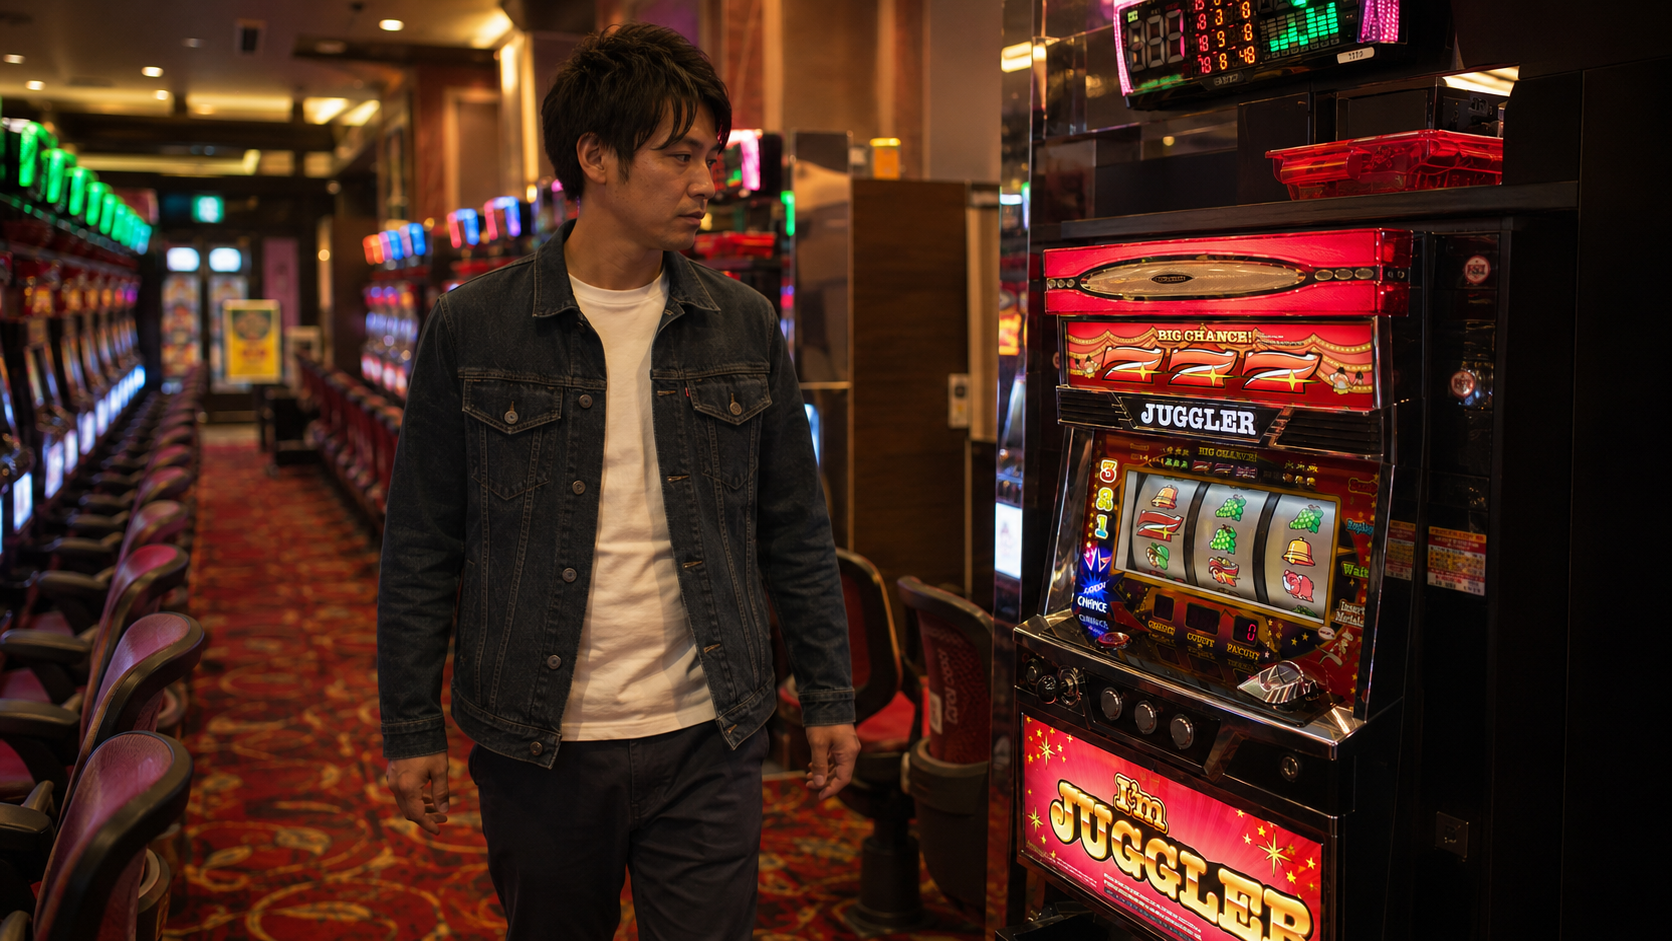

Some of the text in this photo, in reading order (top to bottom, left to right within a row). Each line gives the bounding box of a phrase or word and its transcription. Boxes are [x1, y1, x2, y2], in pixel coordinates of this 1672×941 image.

[1157, 330, 1182, 341] BIG
[1184, 330, 1252, 343] CHANCE!
[1141, 404, 1256, 435] JUGGLER
[1247, 623, 1256, 641] 0
[1114, 773, 1168, 834] I'm
[1050, 780, 1313, 941] JUGGLER
